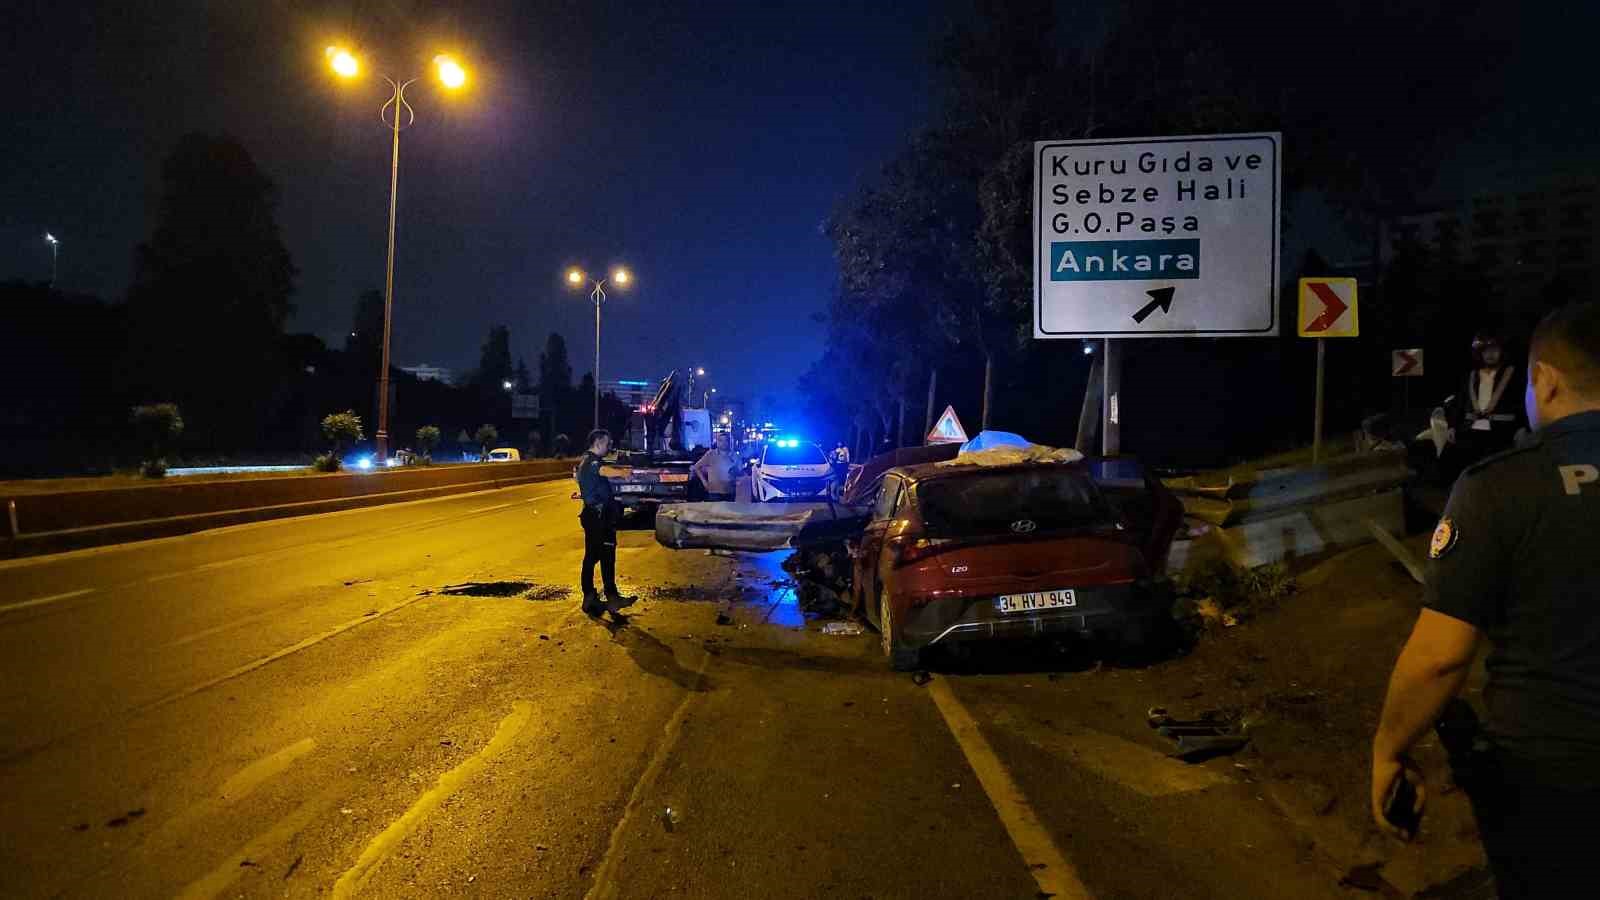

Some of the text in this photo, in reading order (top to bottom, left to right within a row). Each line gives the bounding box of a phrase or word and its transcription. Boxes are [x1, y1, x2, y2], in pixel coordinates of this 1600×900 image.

[1052, 155, 1126, 176] Kuru
[1224, 153, 1262, 170] ve
[1052, 178, 1246, 205] Sebze Hali
[1052, 212, 1199, 234] G.O.Paşa
[1056, 249, 1194, 273] Ankara
[1000, 591, 1072, 610] 34 HVJ 949
